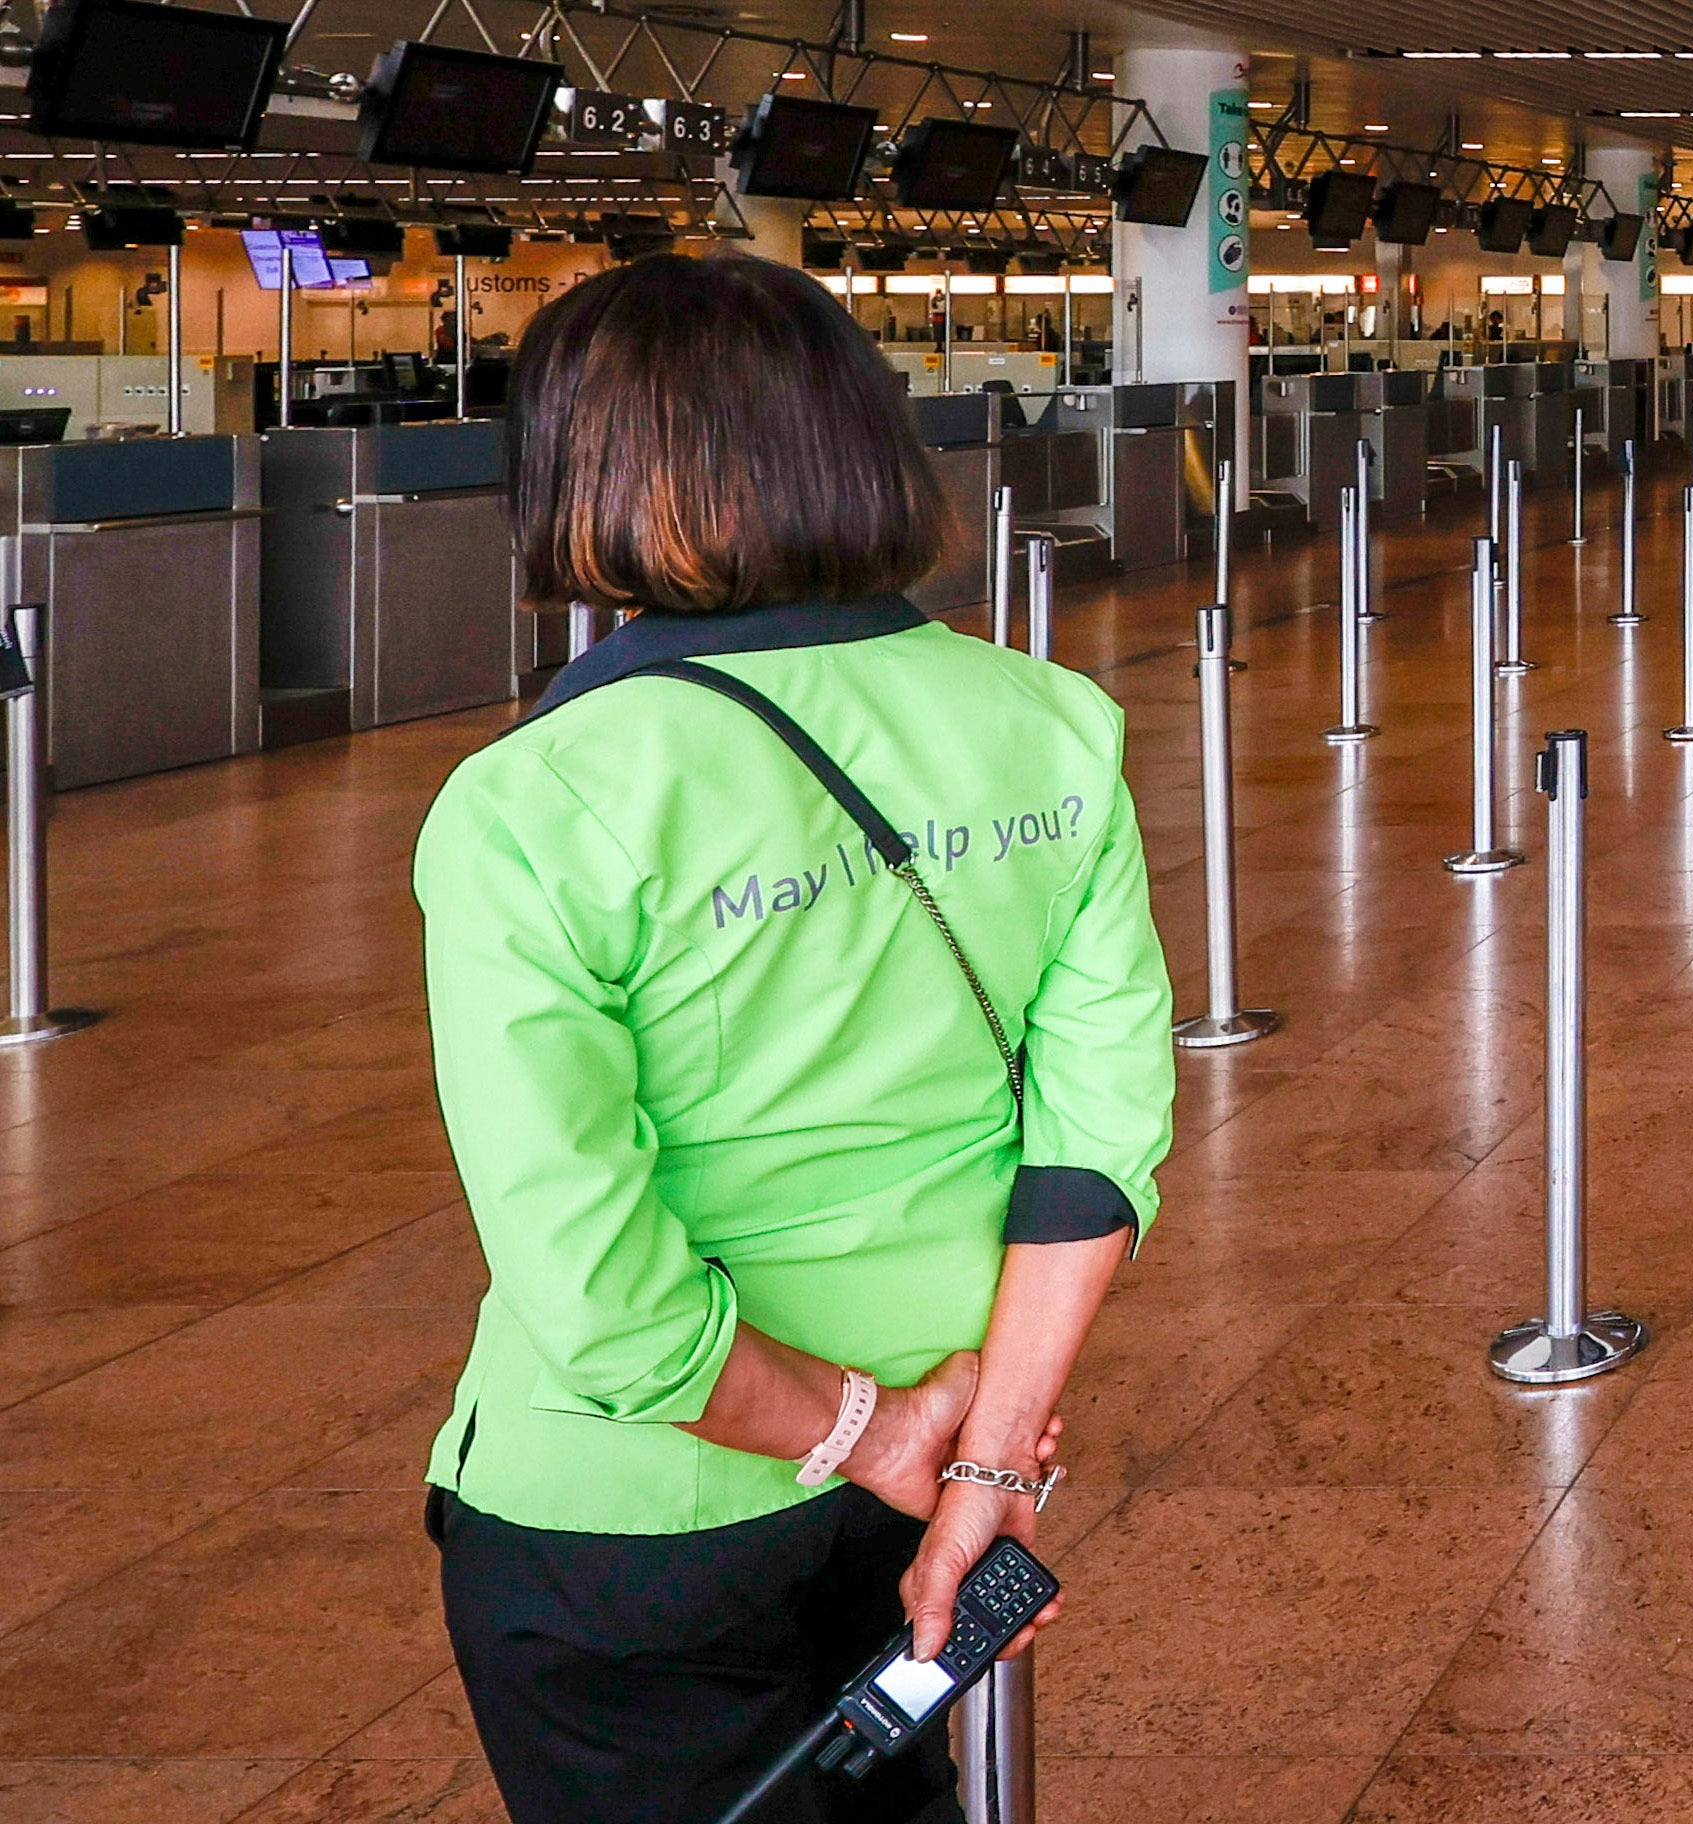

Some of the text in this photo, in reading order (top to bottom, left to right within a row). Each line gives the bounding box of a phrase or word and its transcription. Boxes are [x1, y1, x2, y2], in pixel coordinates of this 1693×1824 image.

[584, 107, 624, 132] 6.2
[674, 117, 710, 140] 6.3
[466, 274, 550, 293] ustoms
[711, 864, 827, 930] May
[836, 844, 855, 887] I
[993, 795, 1084, 862] you?
